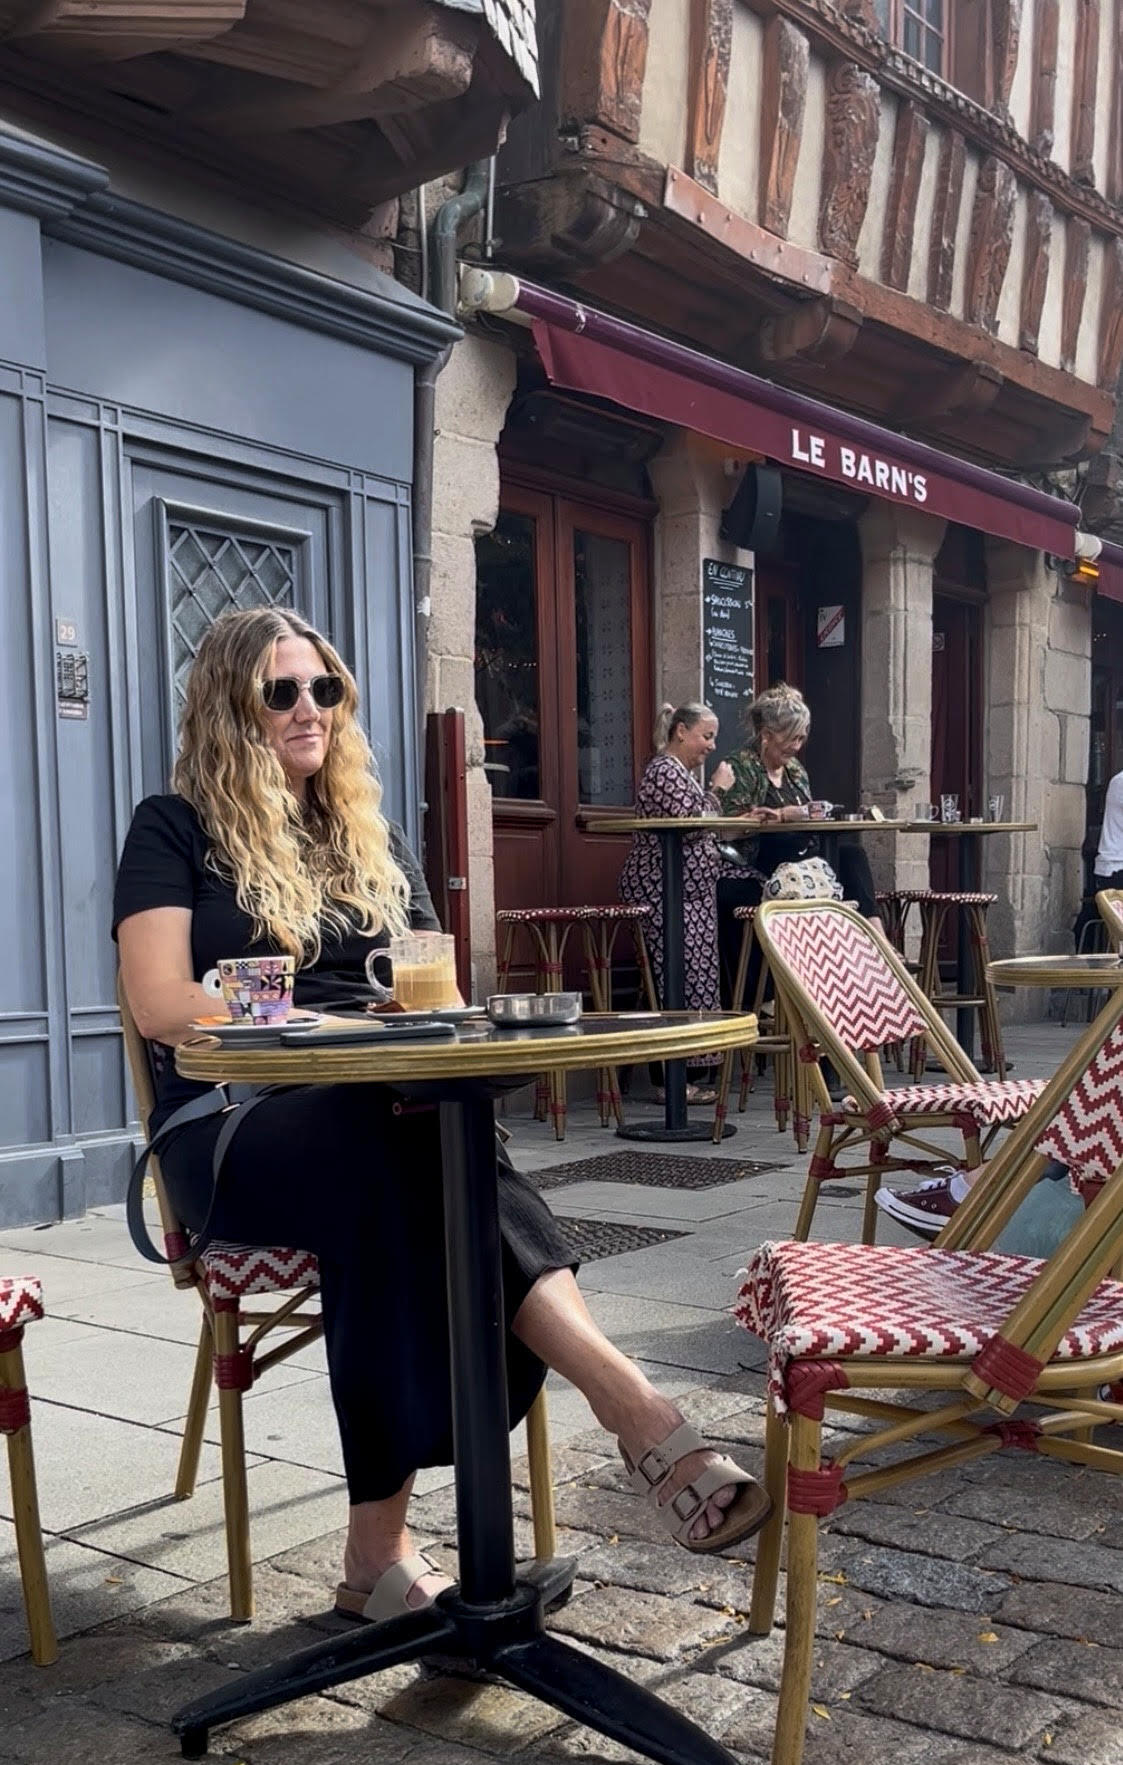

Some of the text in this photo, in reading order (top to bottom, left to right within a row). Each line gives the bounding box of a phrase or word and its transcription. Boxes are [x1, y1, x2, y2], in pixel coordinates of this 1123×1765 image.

[792, 428, 928, 503] LE BARN'S
[59, 624, 76, 641] 29
